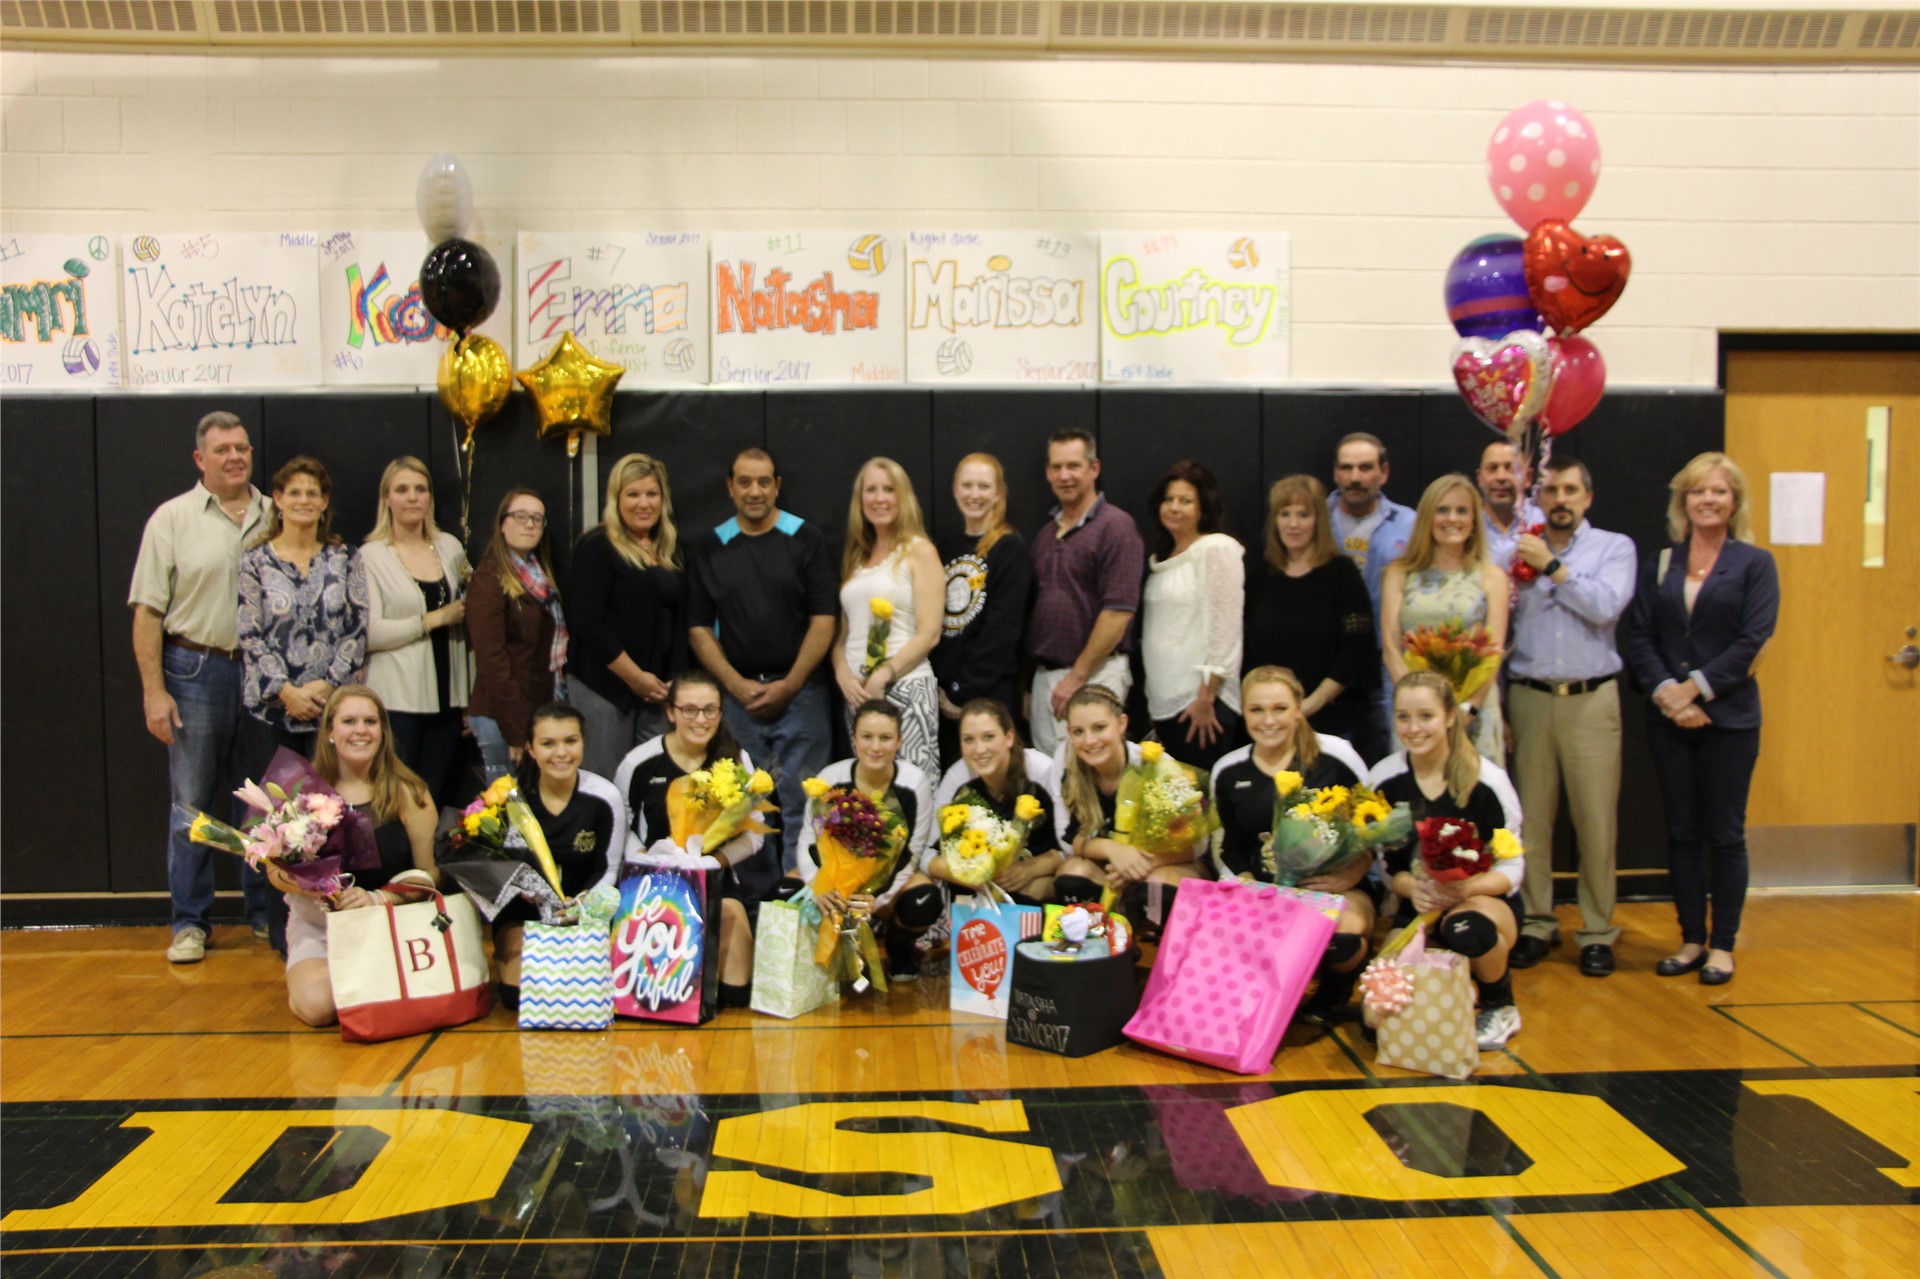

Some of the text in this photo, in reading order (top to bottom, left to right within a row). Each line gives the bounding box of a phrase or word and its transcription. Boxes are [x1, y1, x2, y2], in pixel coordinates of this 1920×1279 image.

[181, 234, 220, 259] #5
[280, 233, 316, 248] Middle
[767, 233, 807, 255] #11
[910, 231, 946, 252] Right
[586, 244, 626, 276] #7
[128, 264, 298, 356] Katelyn
[528, 257, 689, 344] Emma
[716, 259, 881, 335] Natasha
[910, 254, 1085, 335] Marissa
[1102, 254, 1278, 347] Courtney
[133, 363, 233, 386] Senior 2017
[717, 355, 811, 385] Senior 2017
[850, 361, 900, 384] Middle
[631, 874, 667, 922] be
[405, 937, 436, 973] B
[612, 919, 699, 998] you
[957, 936, 1007, 967] CELEBRATE
[635, 957, 694, 1012] tiful
